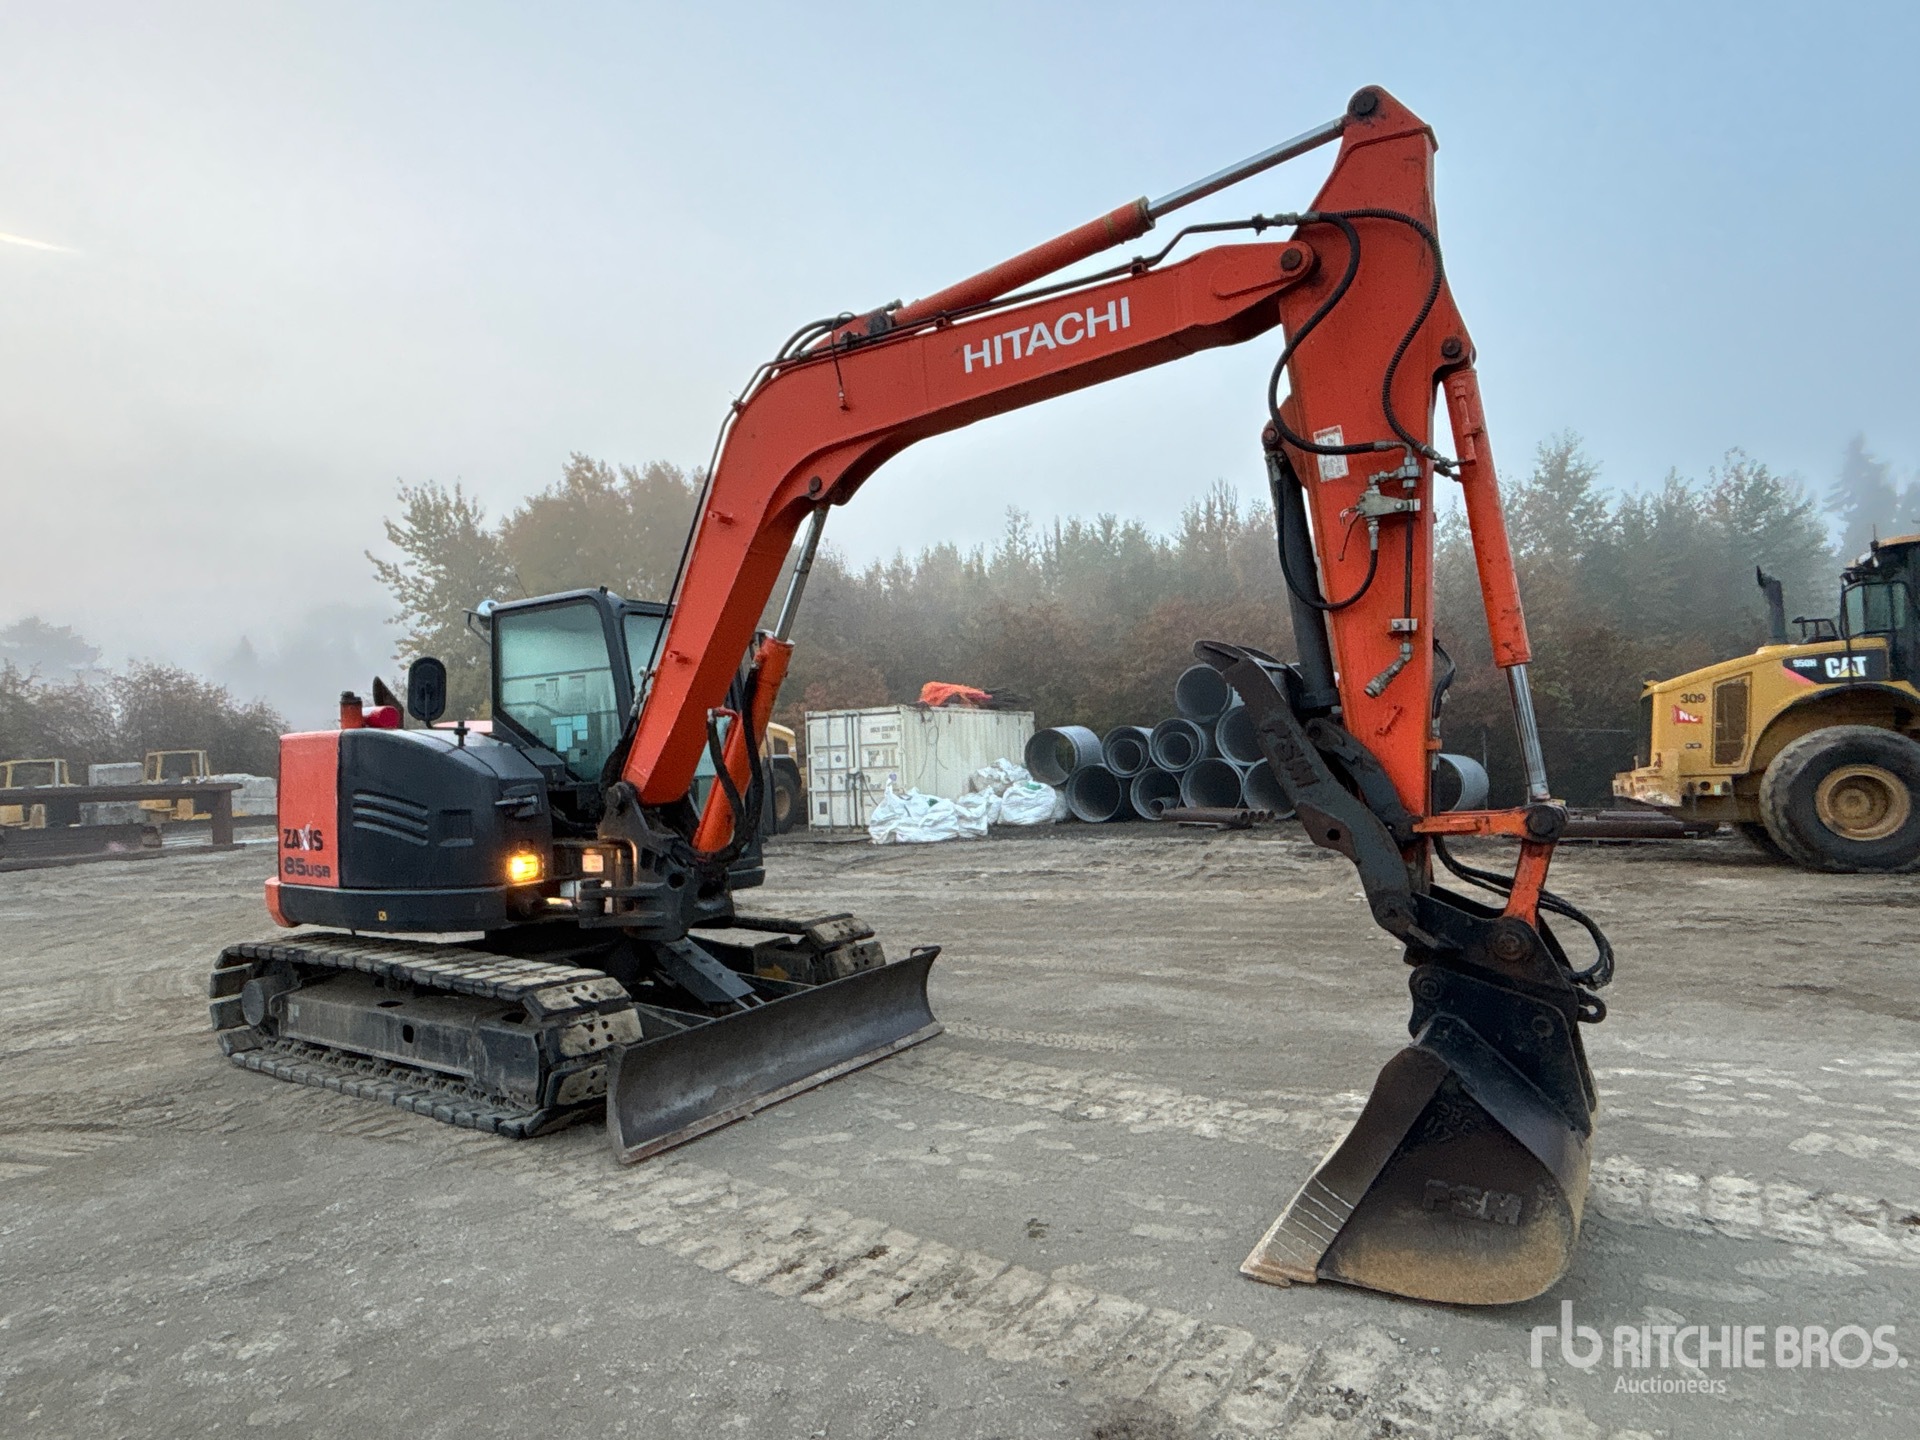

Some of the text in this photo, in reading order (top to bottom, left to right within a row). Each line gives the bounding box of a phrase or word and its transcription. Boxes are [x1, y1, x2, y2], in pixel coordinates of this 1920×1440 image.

[963, 296, 1131, 374] HITACHI
[1824, 656, 1867, 678] CAT
[1680, 693, 1706, 704] 309
[283, 823, 323, 851] ZAXIS
